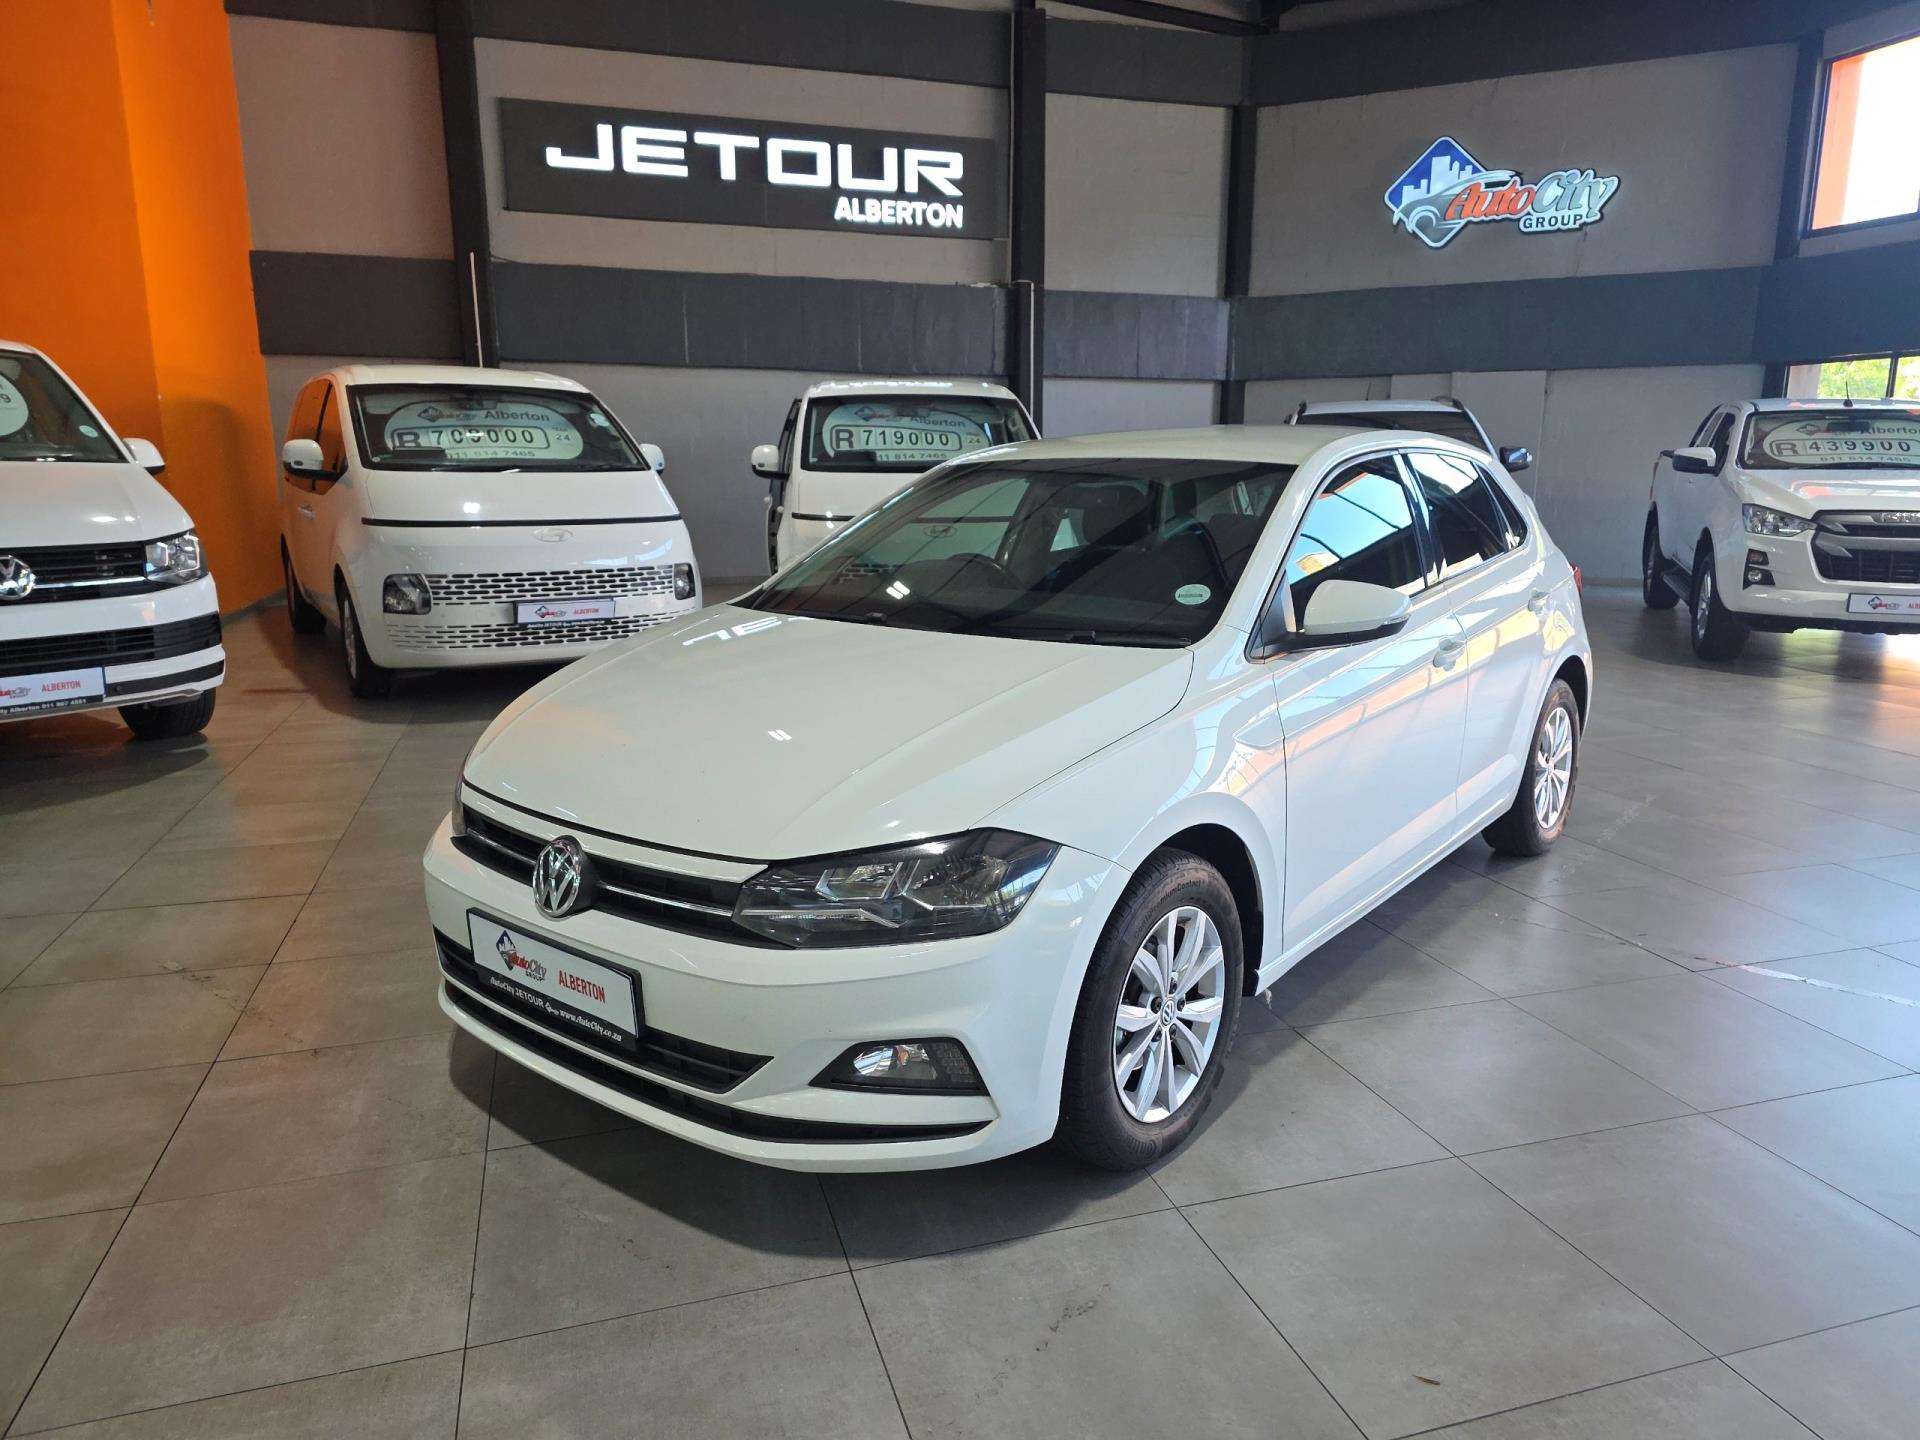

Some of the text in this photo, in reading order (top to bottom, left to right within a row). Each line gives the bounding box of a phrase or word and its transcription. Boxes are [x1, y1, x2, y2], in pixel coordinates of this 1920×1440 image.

[545, 123, 964, 196] JETOUR
[834, 196, 963, 228] ALBERTON
[1523, 214, 1583, 229] GROUP
[484, 410, 550, 422] Alberton
[835, 429, 950, 449] R 719000
[1775, 440, 1912, 455] R 439900
[41, 680, 81, 692] ALBERTON
[558, 968, 606, 1004] ALBERTON
[515, 987, 545, 1009] JETOUR
